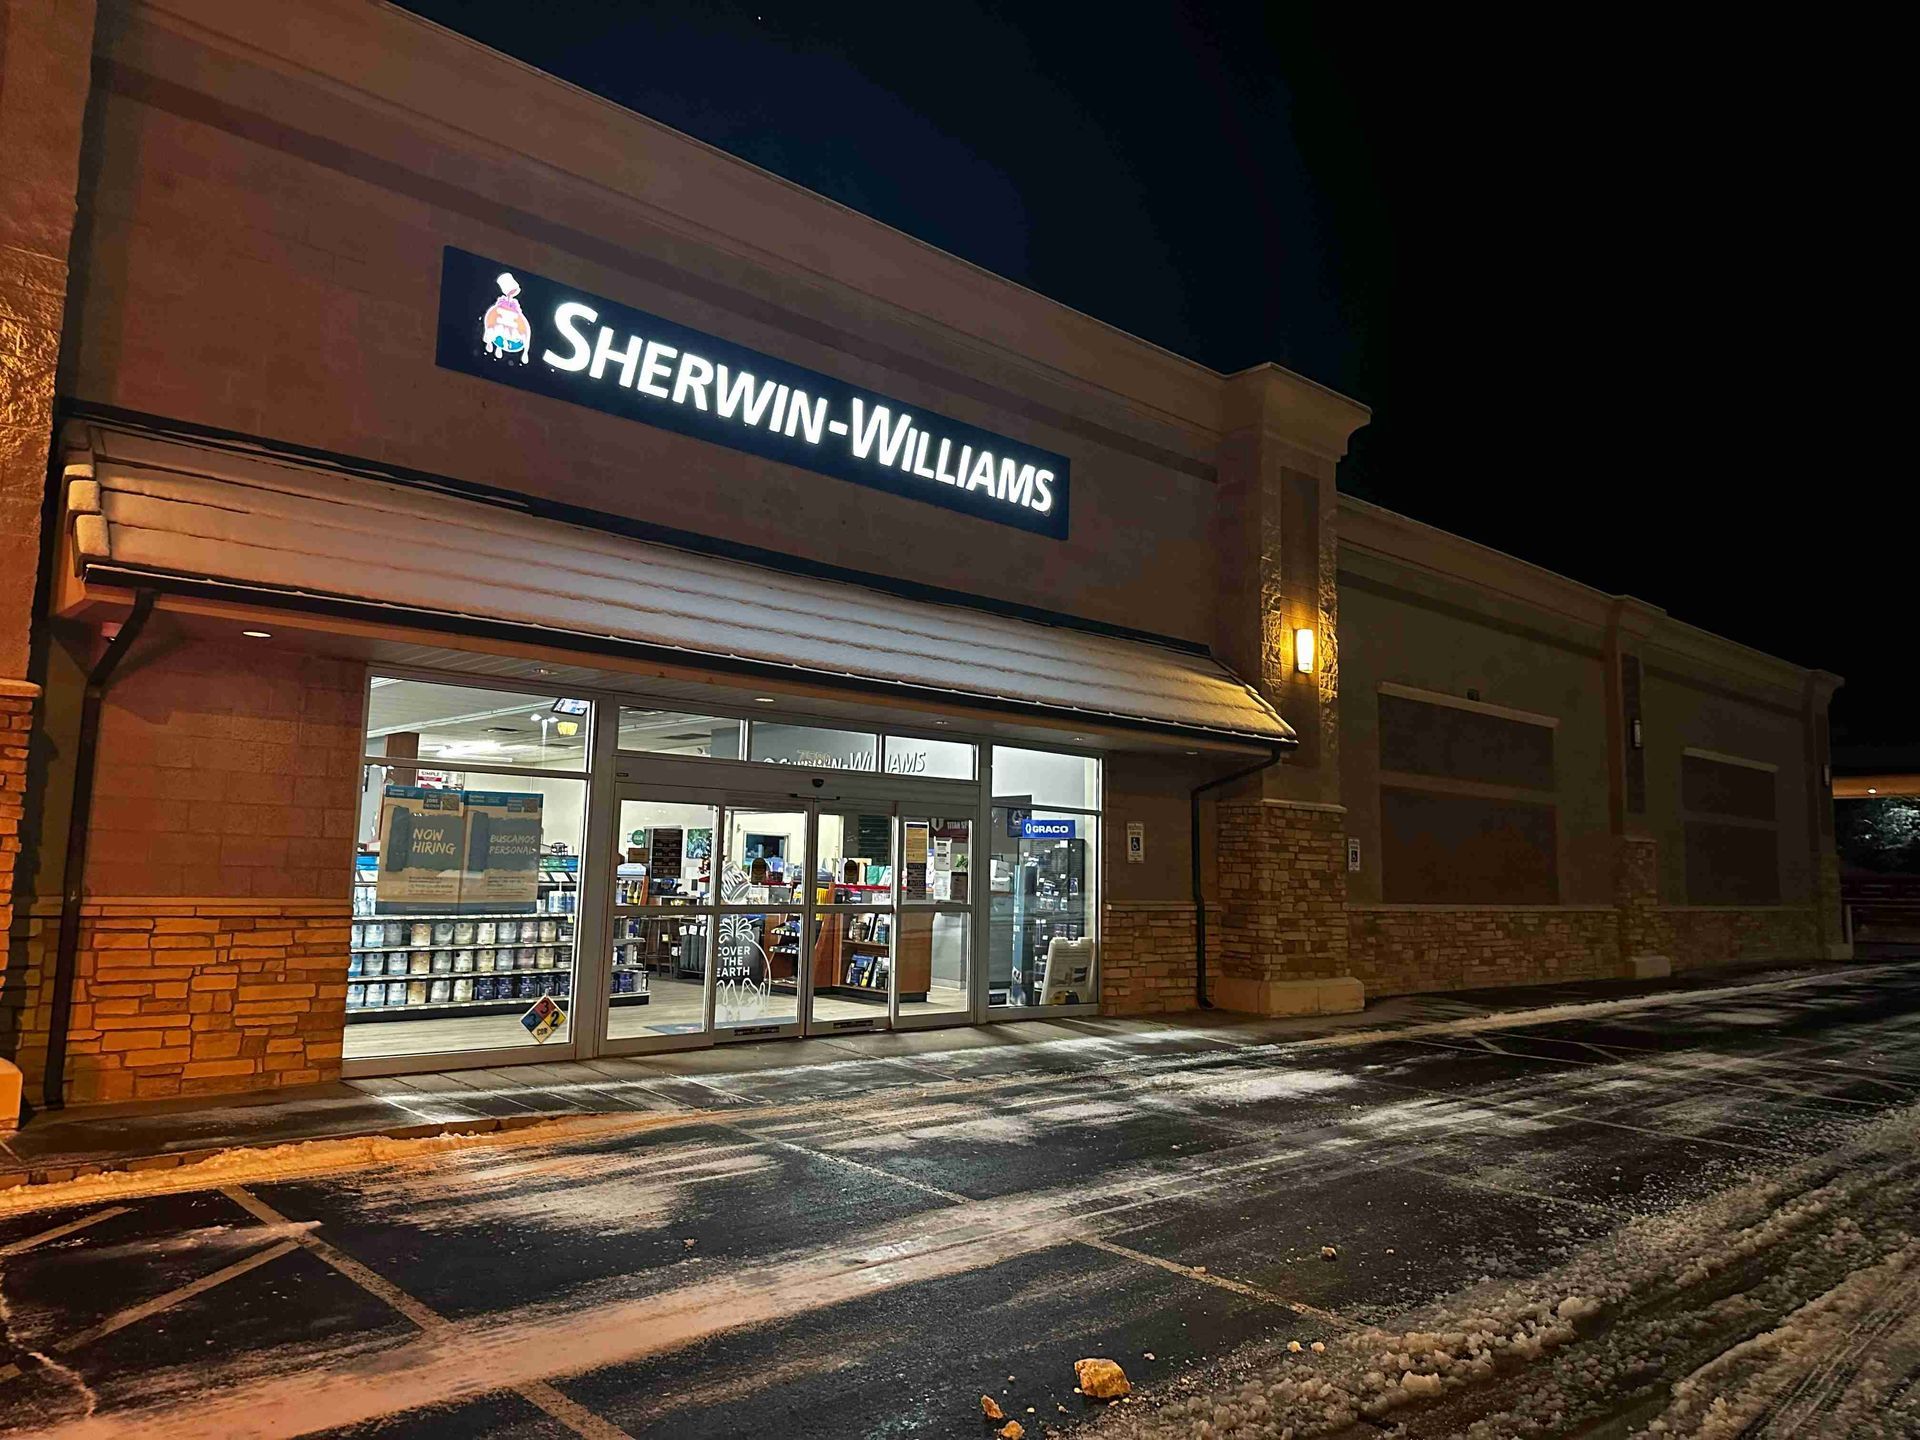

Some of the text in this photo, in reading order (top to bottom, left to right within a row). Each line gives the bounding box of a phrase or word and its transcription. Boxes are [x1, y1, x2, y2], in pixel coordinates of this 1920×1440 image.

[543, 302, 1055, 513] SHERWIN-WILLIAMS
[413, 828, 444, 841] NOW
[1032, 825, 1069, 833] GRACO
[490, 835, 536, 844] BUSCAMOS
[412, 843, 457, 855] HIRING
[489, 846, 536, 855] PERSONAL
[722, 957, 743, 966] THE
[541, 1000, 549, 1014] 3
[551, 1011, 559, 1027] 2
